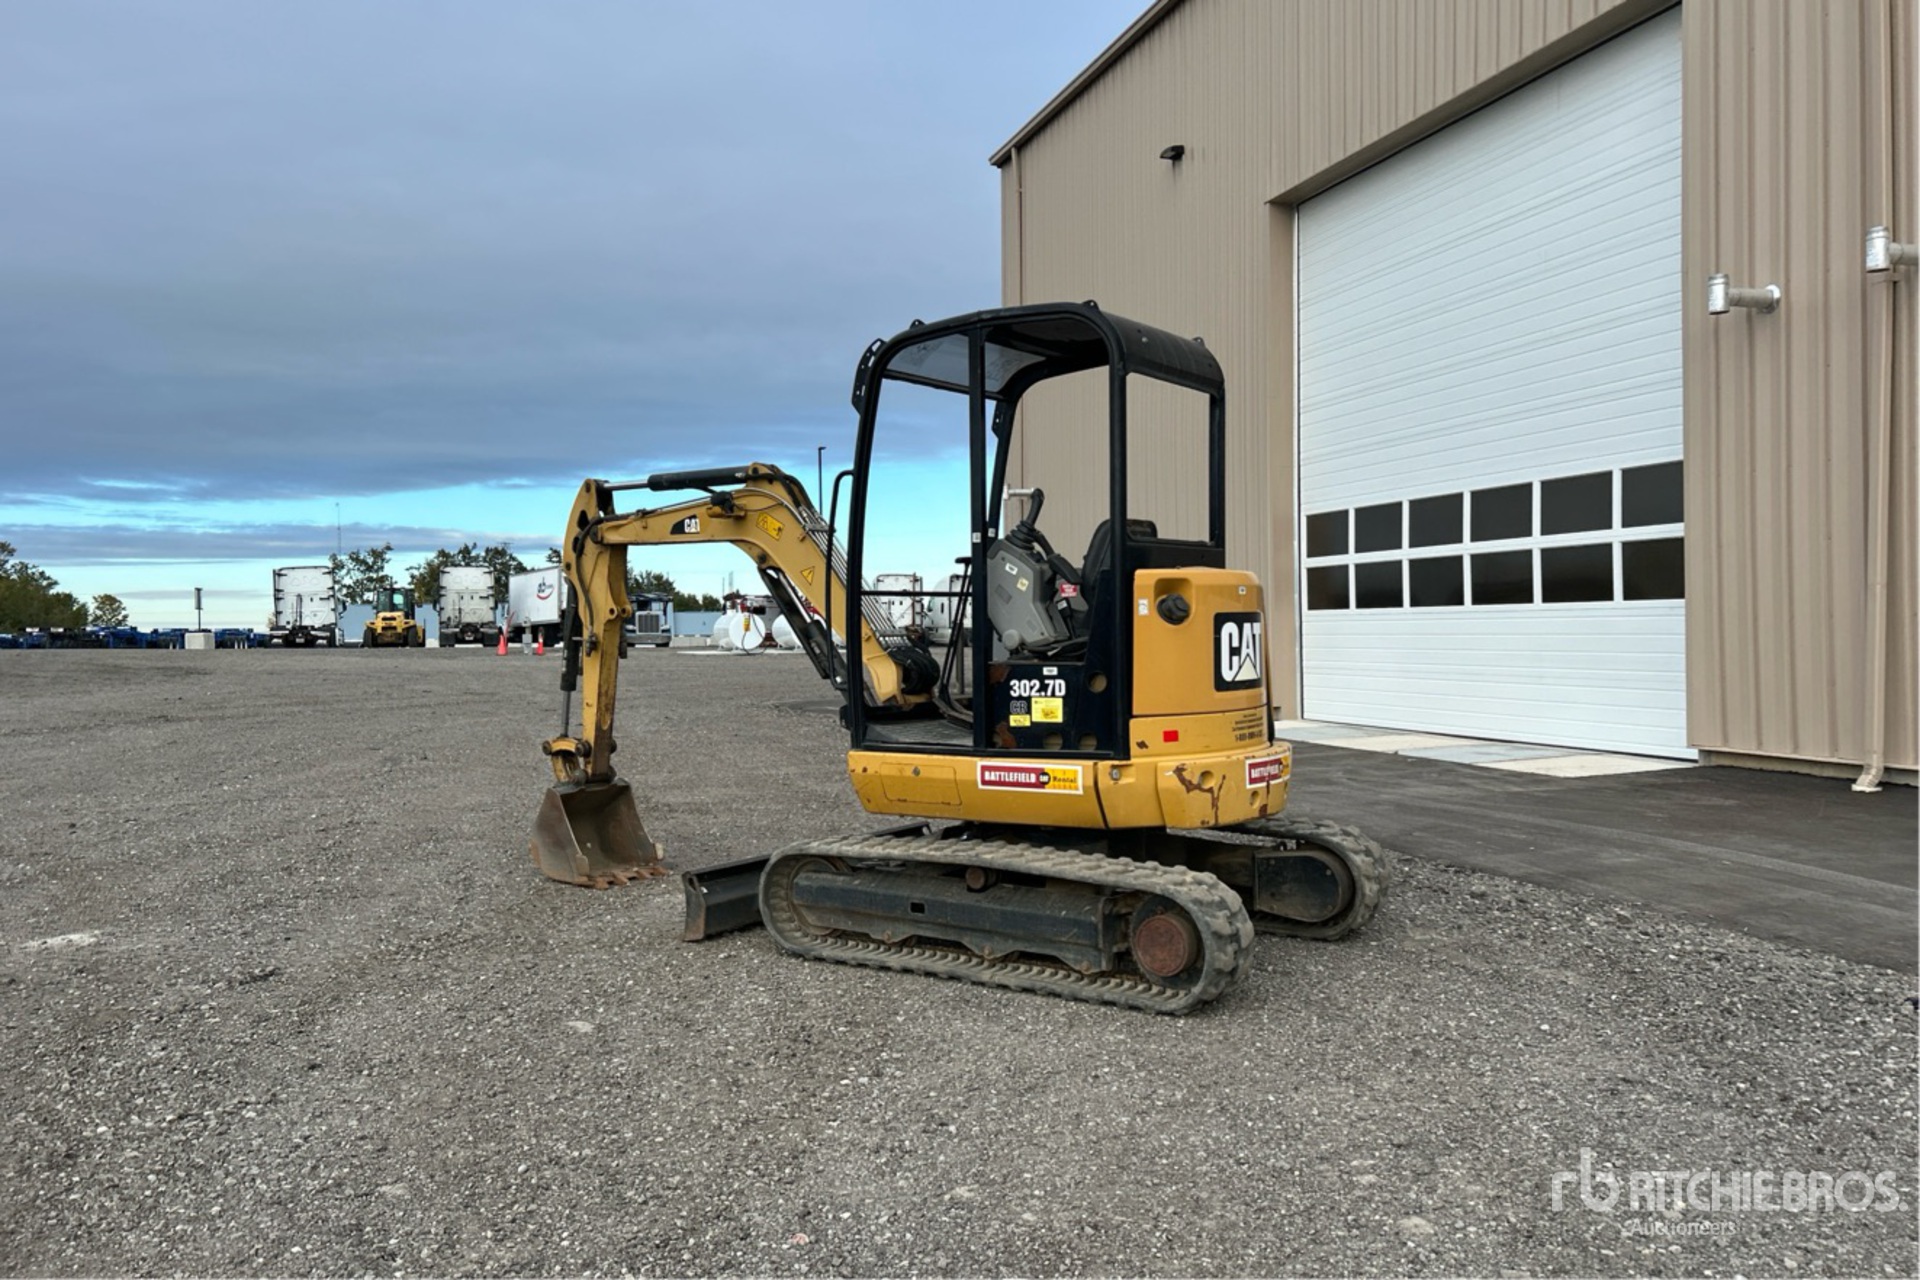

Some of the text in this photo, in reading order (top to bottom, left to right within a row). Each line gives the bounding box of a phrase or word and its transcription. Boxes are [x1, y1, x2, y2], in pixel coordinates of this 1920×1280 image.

[684, 518, 700, 533] CAT
[1220, 622, 1262, 682] CAT
[1010, 679, 1066, 697] 302.7D
[984, 770, 1036, 784] BATTLEFIELD
